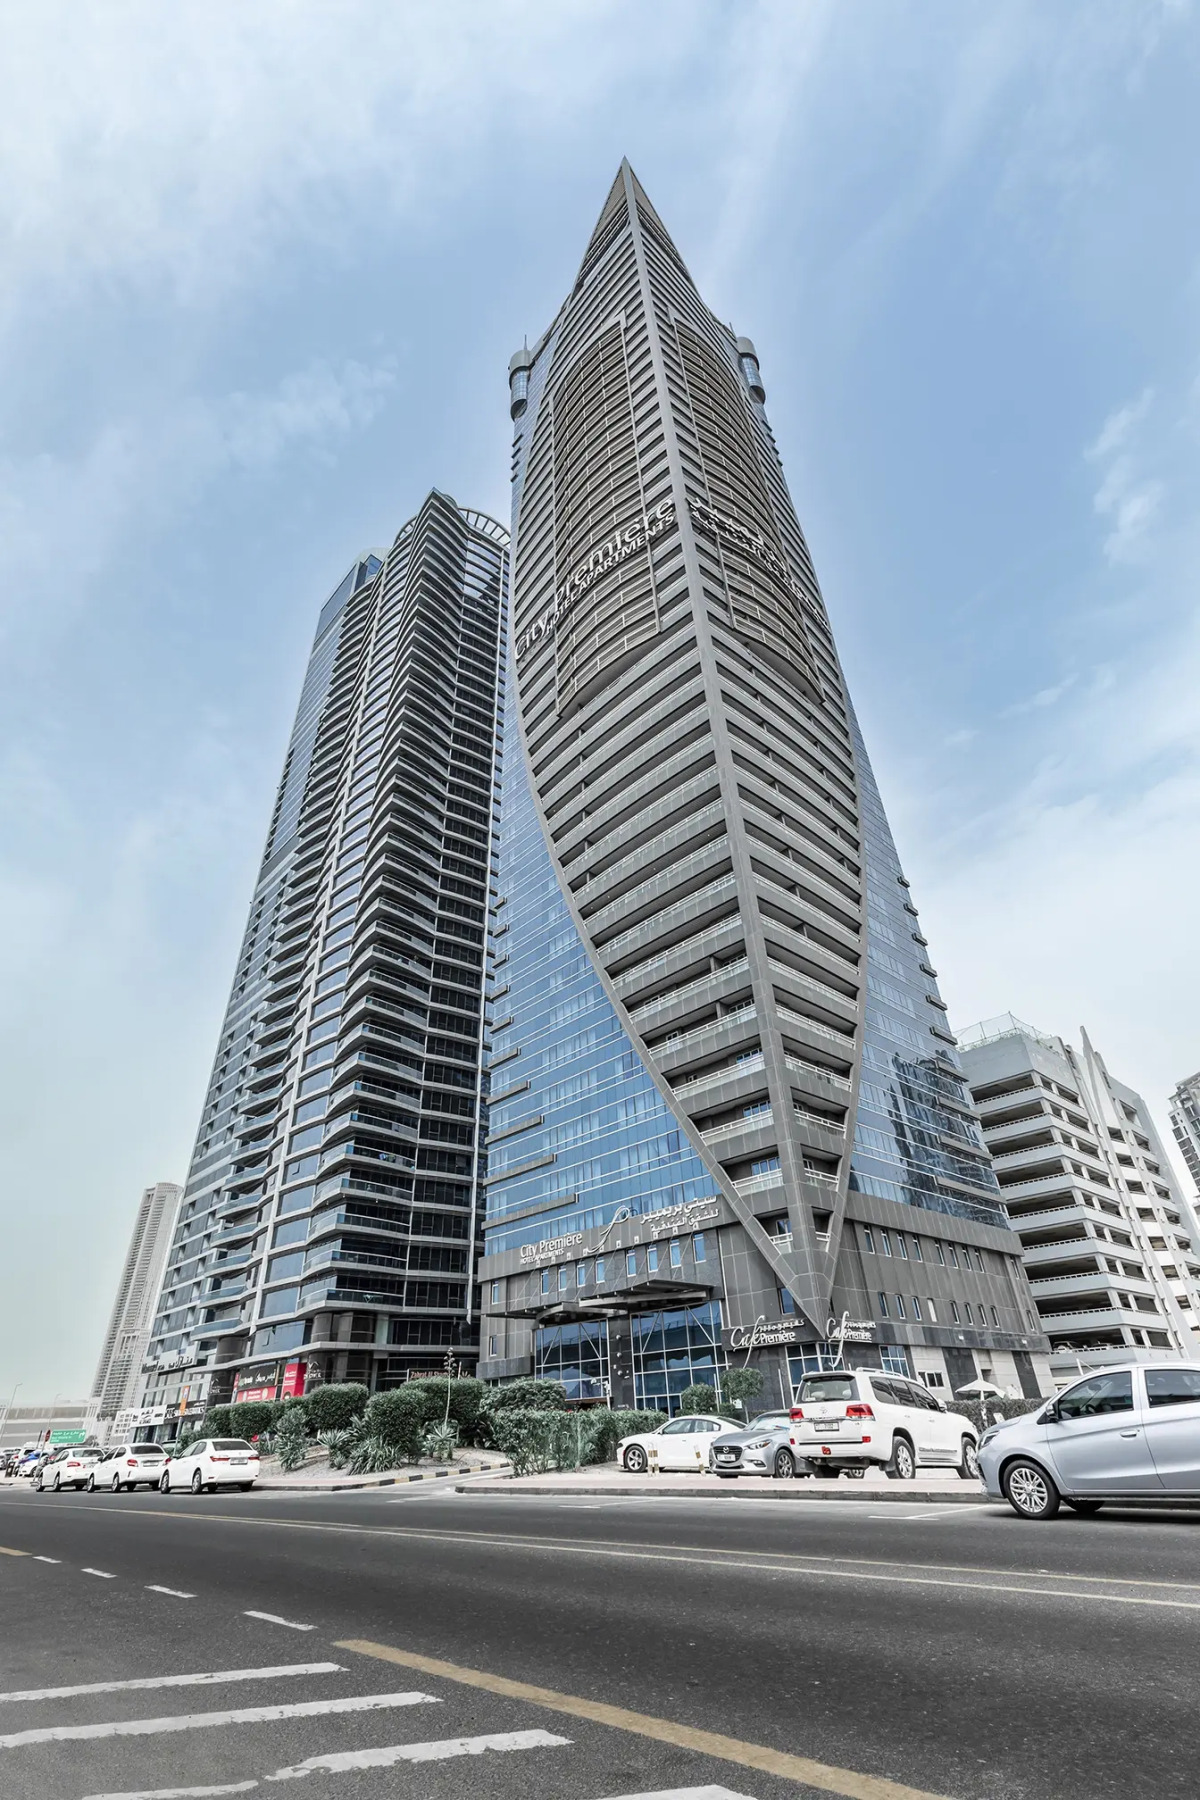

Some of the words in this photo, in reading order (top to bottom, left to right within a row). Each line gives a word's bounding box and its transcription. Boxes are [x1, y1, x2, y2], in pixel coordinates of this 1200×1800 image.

[544, 588, 579, 635] HOTEL
[578, 511, 675, 594] APARTMENTS
[514, 610, 549, 660] City
[520, 1243, 538, 1258] City
